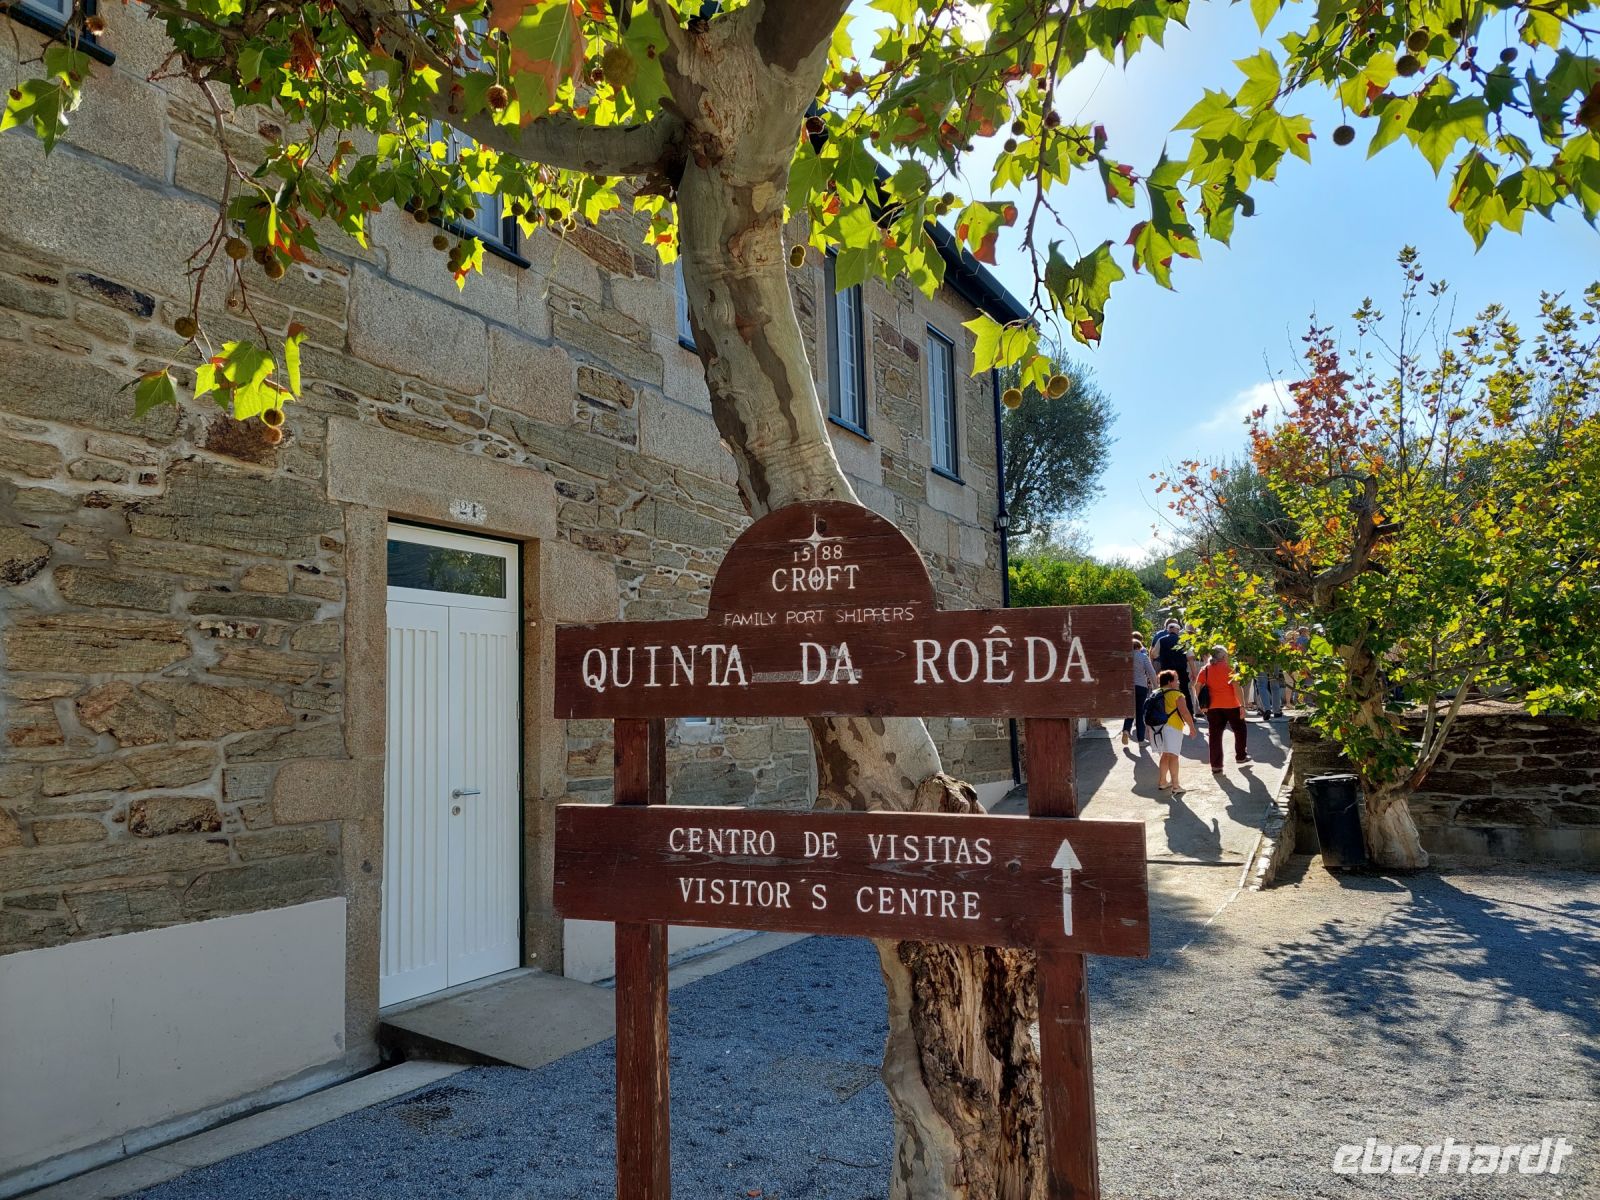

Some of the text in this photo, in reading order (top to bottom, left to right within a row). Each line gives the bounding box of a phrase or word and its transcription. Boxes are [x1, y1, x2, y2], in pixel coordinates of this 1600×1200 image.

[771, 564, 860, 592] CROFT
[723, 606, 915, 626] FAMILY PORT SHIPPERS
[582, 625, 1095, 693] QUINTA DA ROÊDA
[669, 827, 992, 865] CENTRO DE VISITAS
[856, 886, 981, 920] CENTRE
